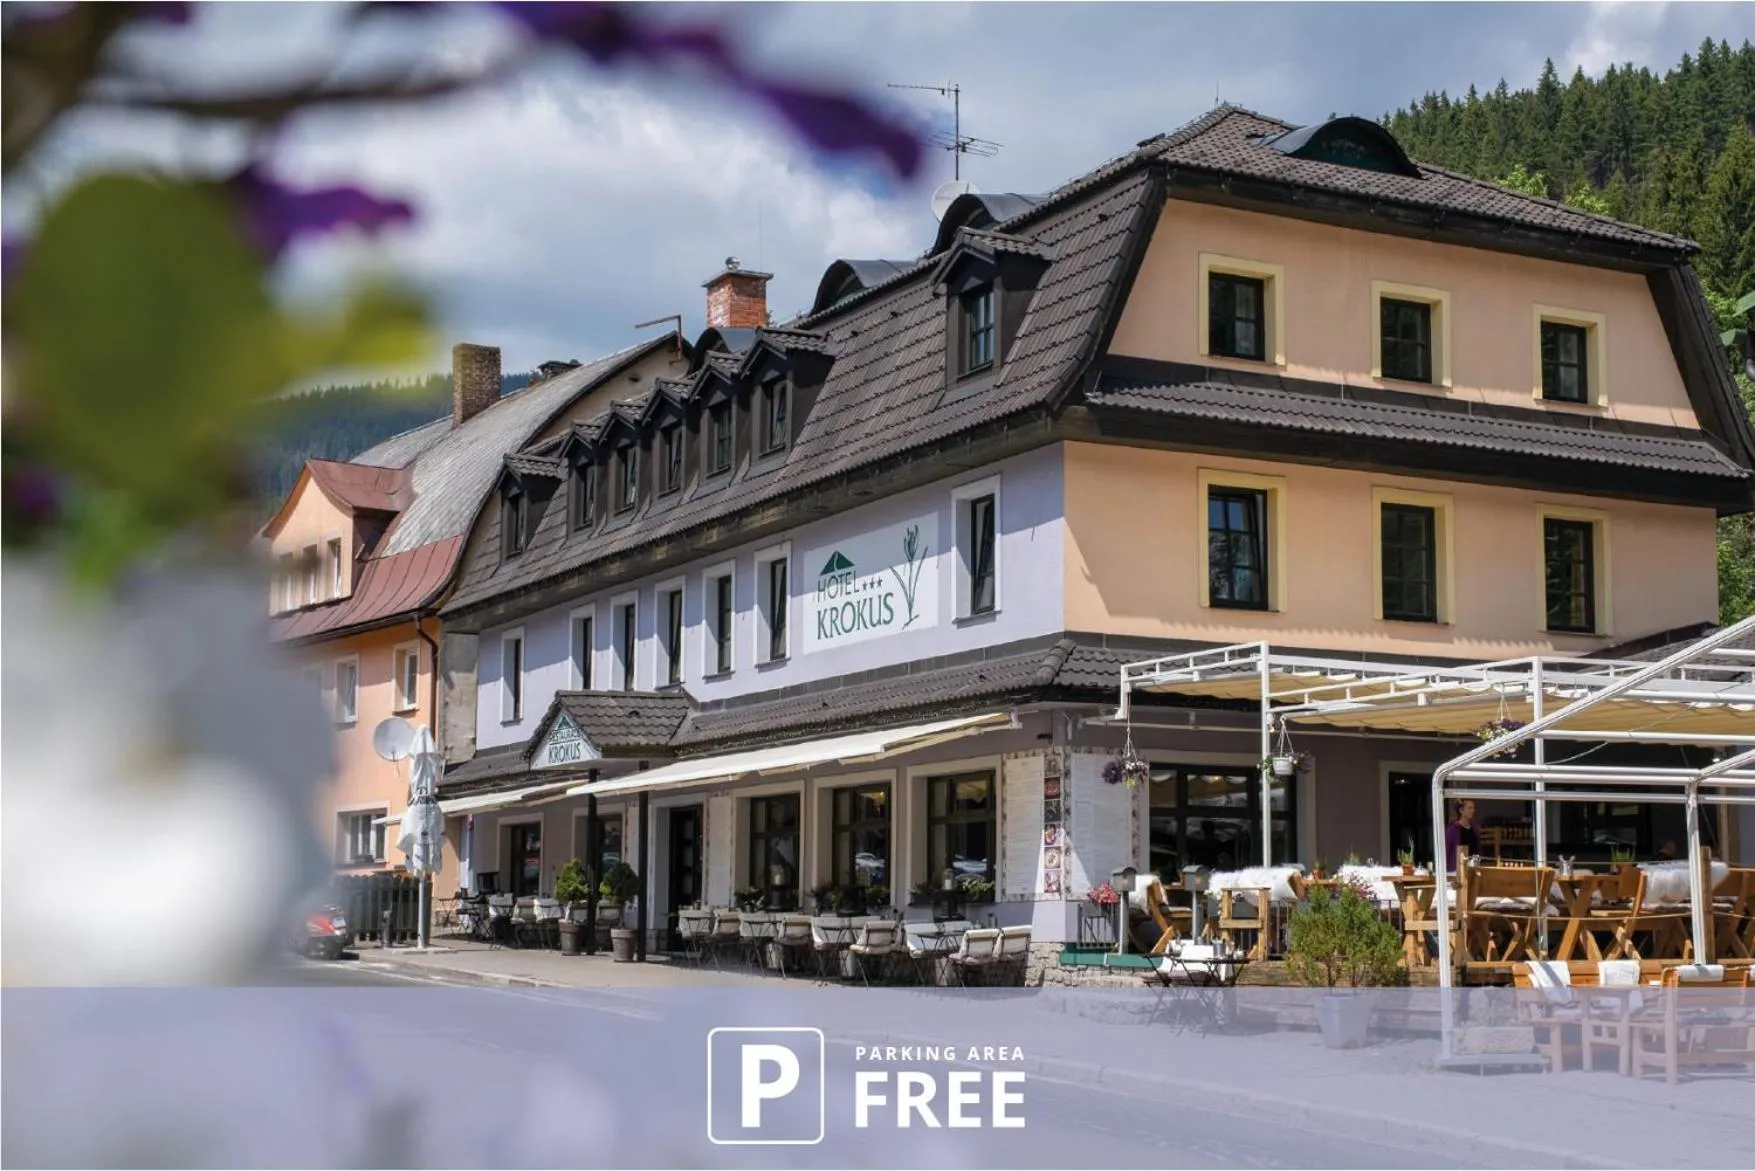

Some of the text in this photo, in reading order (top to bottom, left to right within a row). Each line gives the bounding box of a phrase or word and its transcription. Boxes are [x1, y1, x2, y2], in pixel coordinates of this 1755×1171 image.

[817, 570, 860, 602] HOTEL
[817, 592, 894, 640] KROKUS
[549, 742, 581, 764] KROKUS
